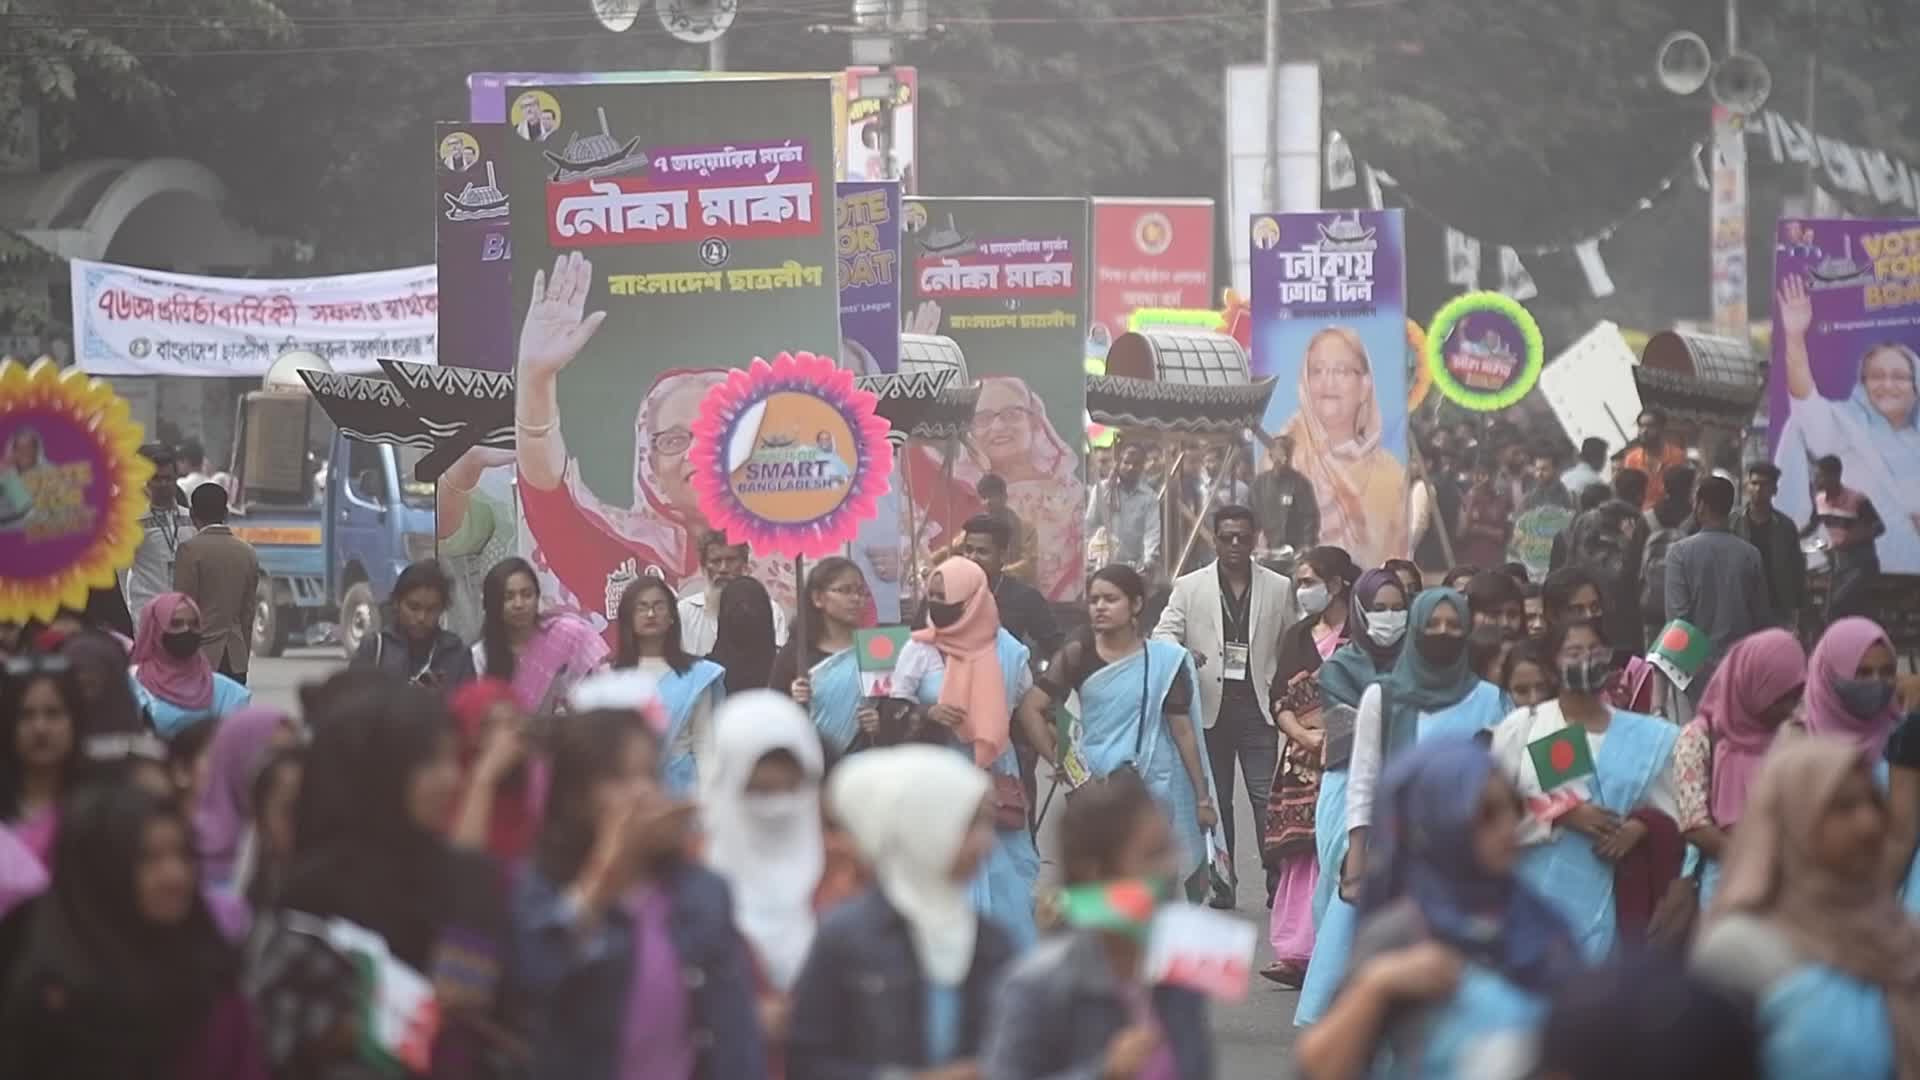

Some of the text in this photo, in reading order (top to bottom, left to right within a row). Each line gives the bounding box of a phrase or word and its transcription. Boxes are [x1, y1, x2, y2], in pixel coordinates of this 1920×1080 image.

[556, 165, 813, 237] নৌকা মার্কা
[838, 188, 890, 227] OTE
[838, 222, 880, 256] OR
[1860, 229, 1920, 260] VOT
[608, 260, 824, 296] বাংলাদেশ ছাত্রলীগ
[838, 250, 896, 292] OAT
[921, 257, 999, 291] নৌকা
[1005, 251, 1073, 288] মার্কা
[737, 478, 833, 494] BANGLADESH
[745, 459, 830, 480] SMART
